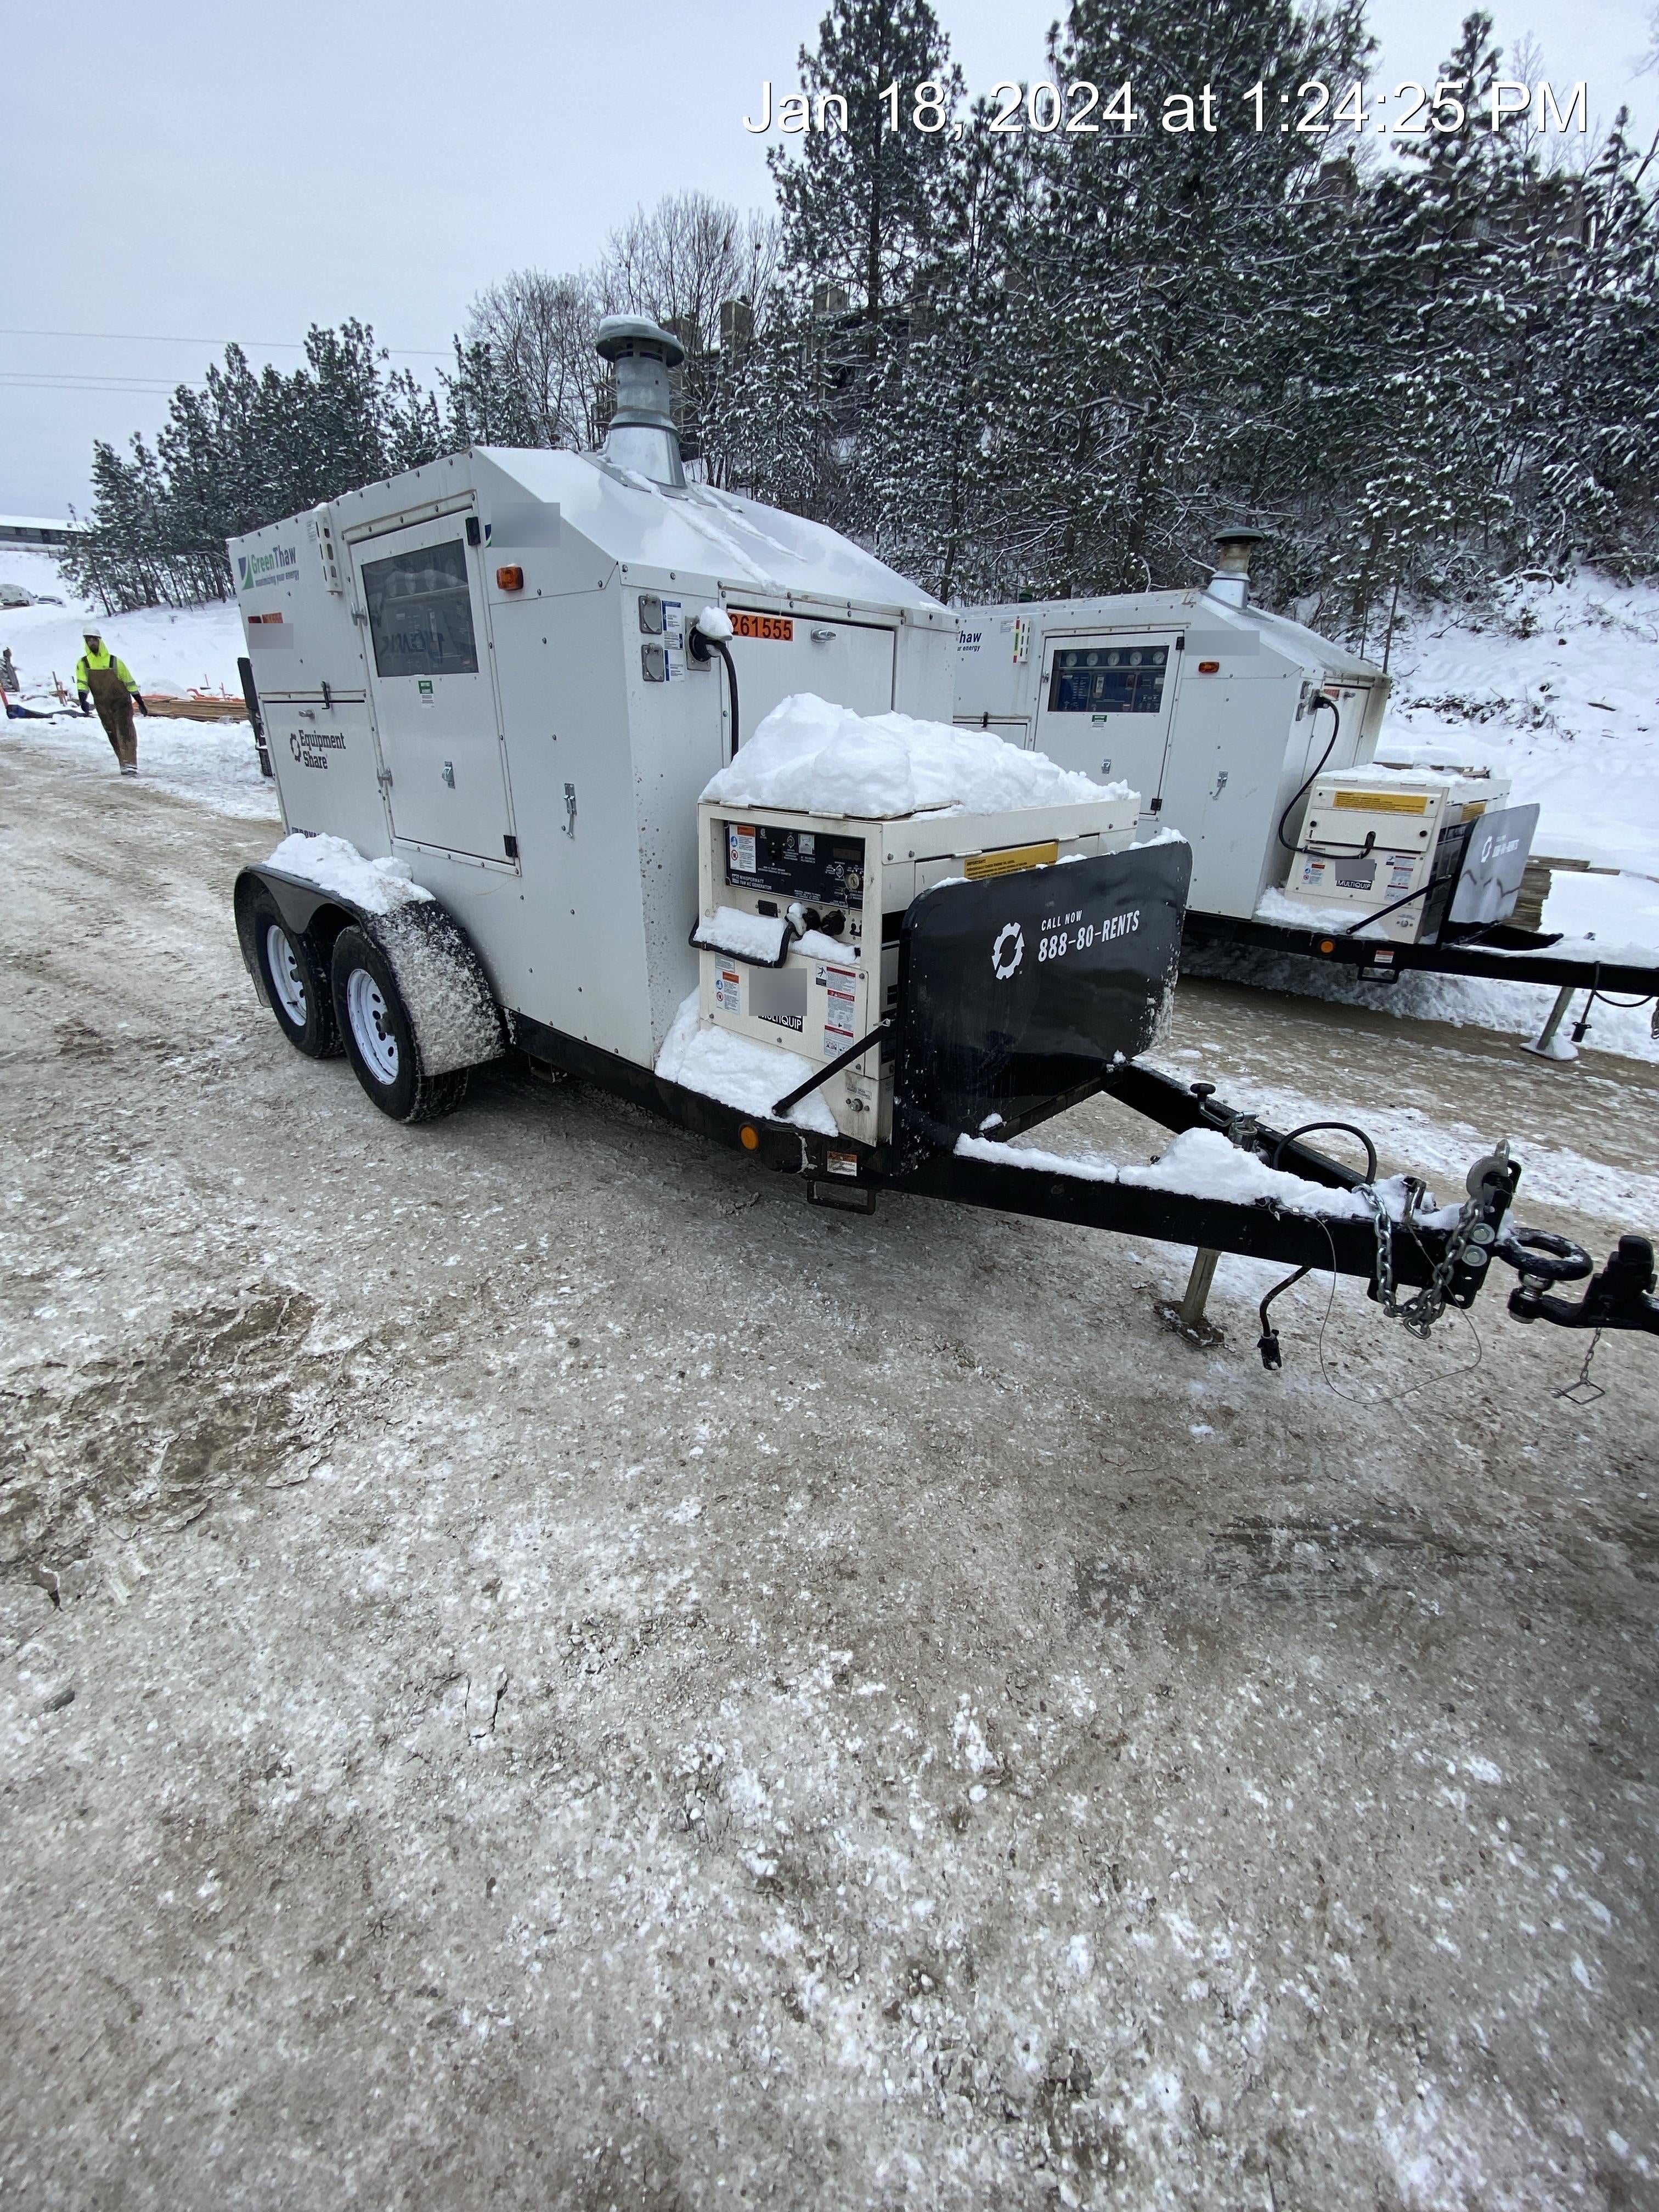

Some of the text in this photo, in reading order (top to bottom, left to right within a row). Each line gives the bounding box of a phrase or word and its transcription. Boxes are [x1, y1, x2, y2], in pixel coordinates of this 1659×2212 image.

[730, 615, 792, 641] 261555
[958, 630, 982, 644] haw
[298, 730, 346, 752] Equipment
[303, 751, 328, 769] Share
[1337, 880, 1371, 889] MULTIQUIP
[1041, 910, 1082, 931] CALL NOW
[1038, 910, 1140, 962] 888-80-RENTS
[759, 1015, 802, 1030] LTIQUIP
